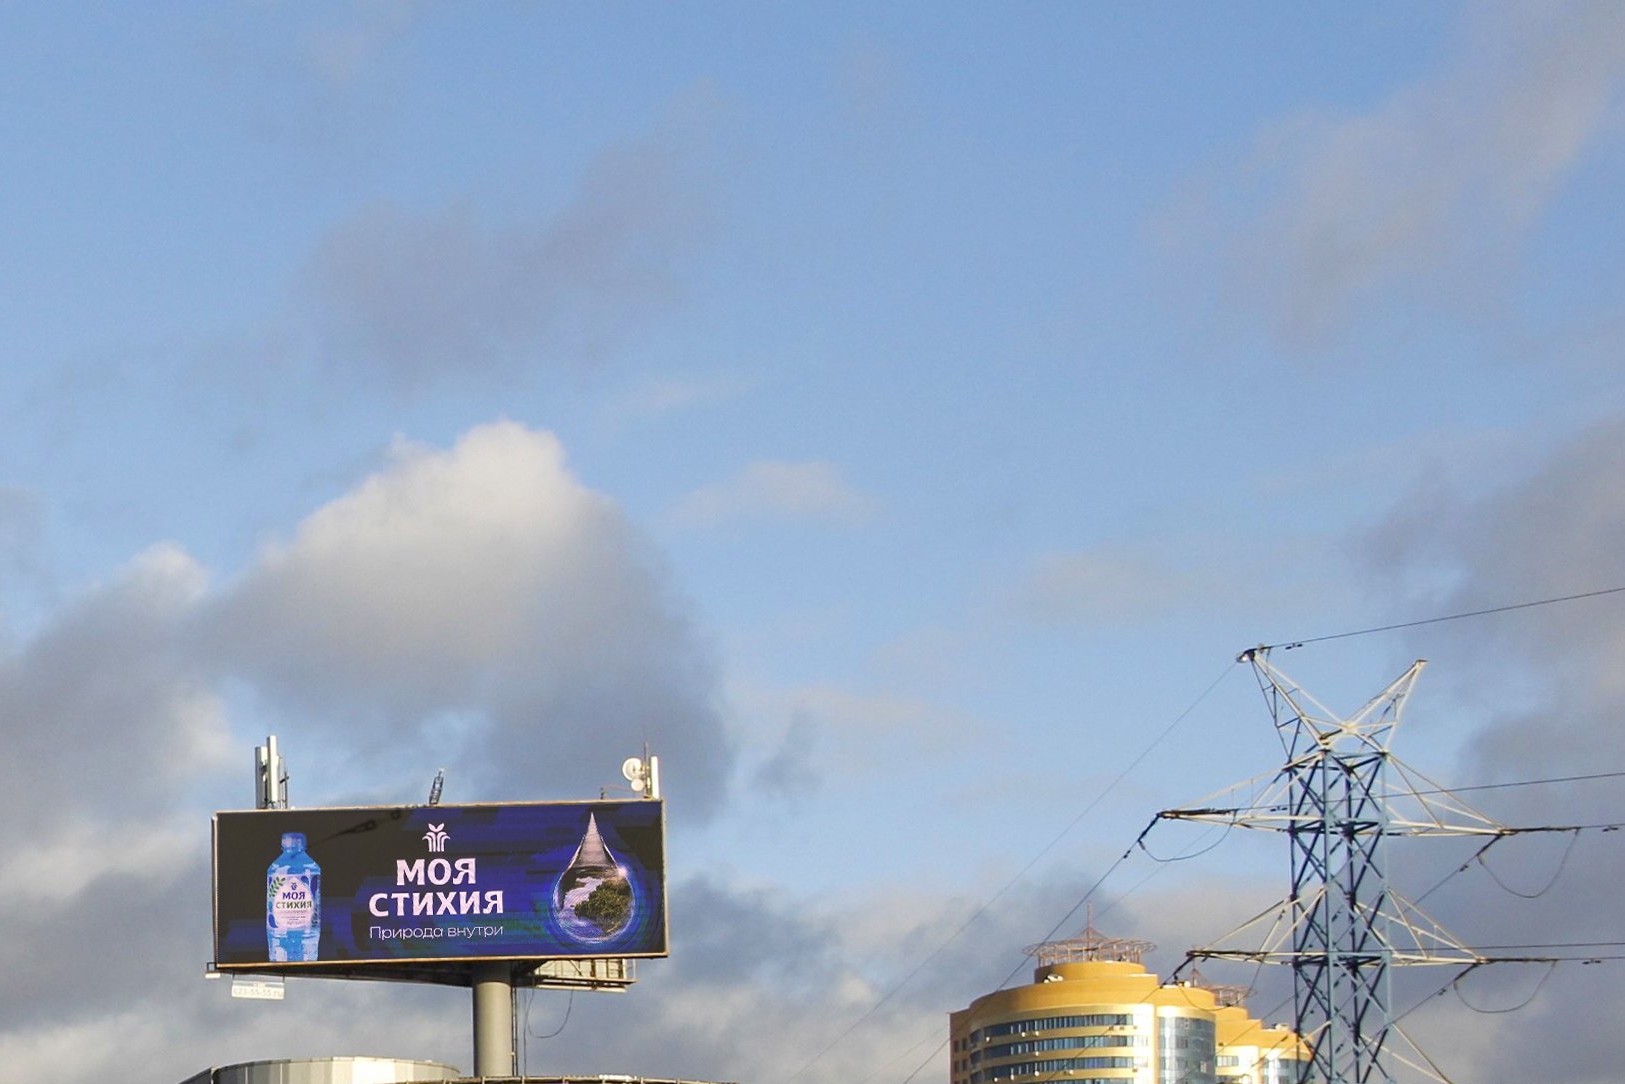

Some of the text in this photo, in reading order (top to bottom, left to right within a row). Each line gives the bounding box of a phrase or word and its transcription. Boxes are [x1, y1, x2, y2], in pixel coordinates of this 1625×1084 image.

[396, 858, 476, 886] МОЯ
[282, 891, 305, 900] МОЯ
[276, 901, 312, 909] СТИХИЯ
[369, 890, 504, 917] СТИХИЯ
[369, 926, 504, 940] Природа внутри
